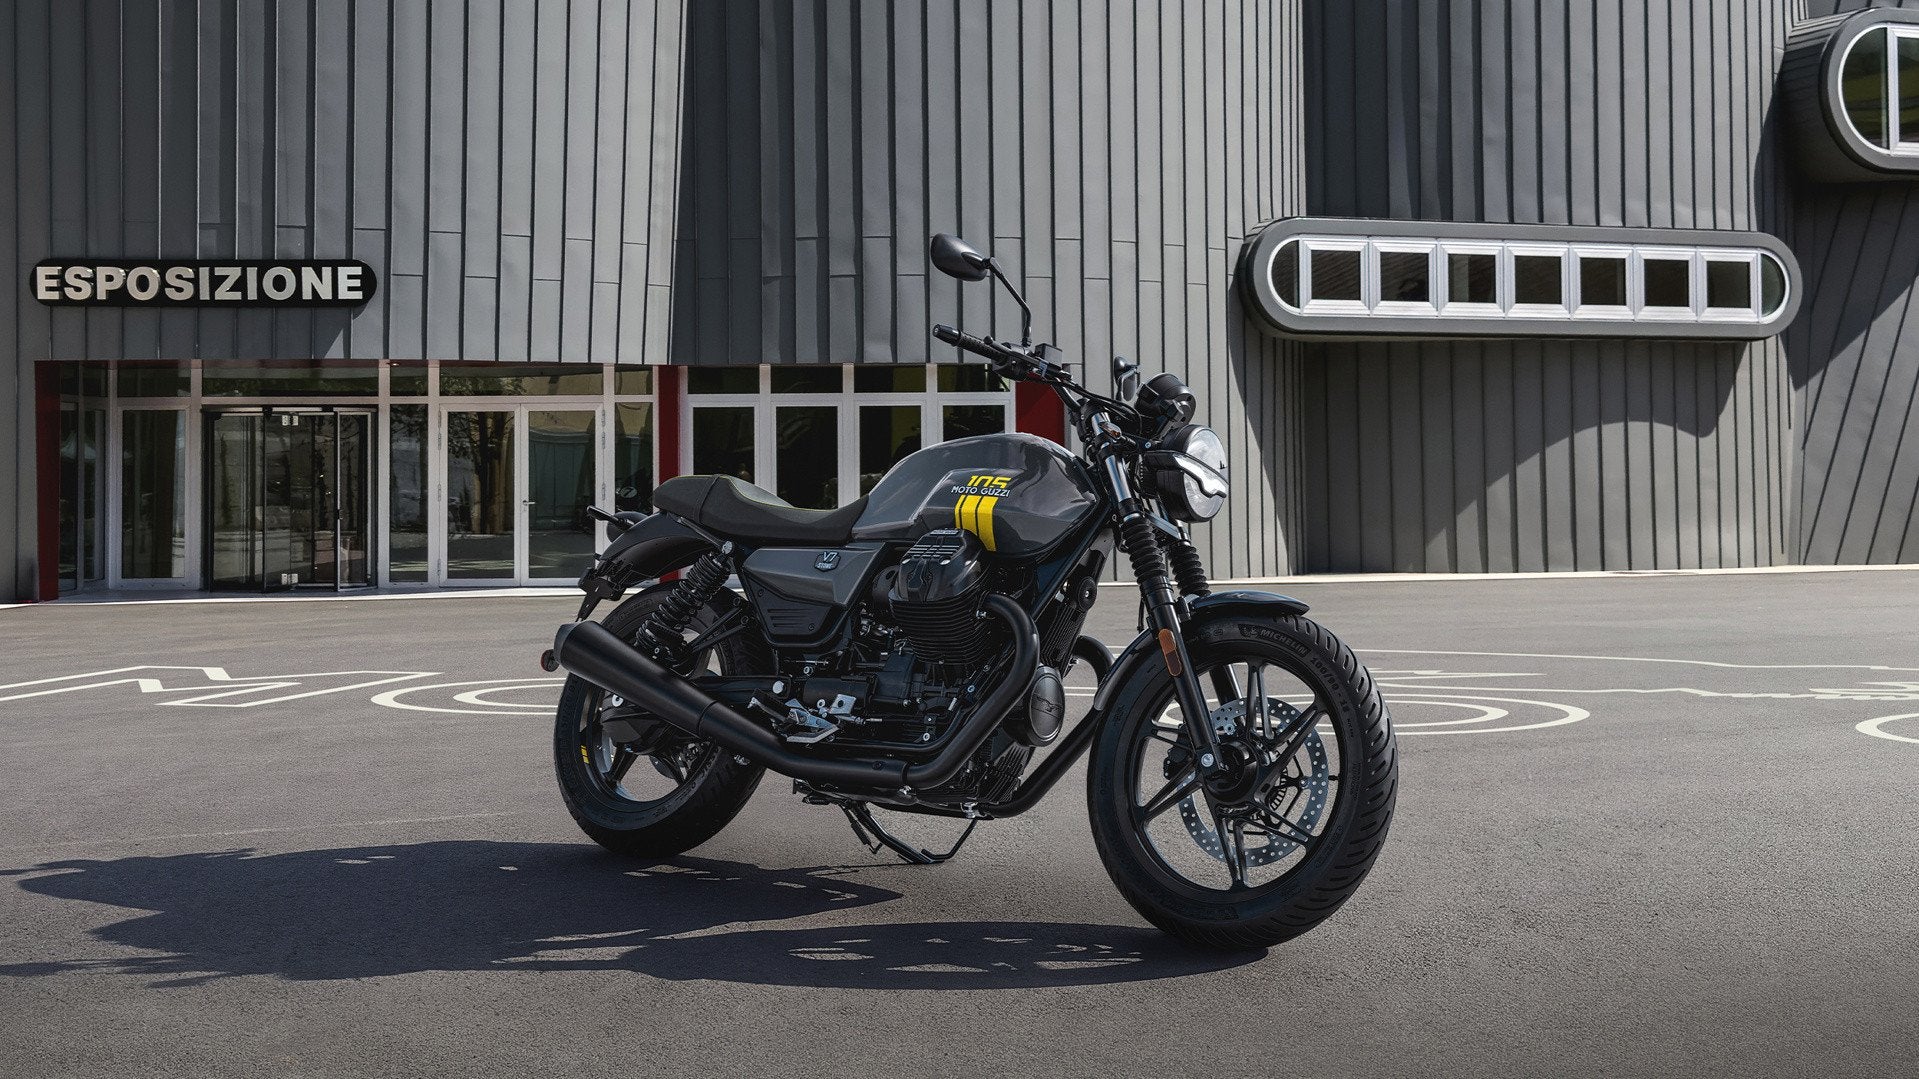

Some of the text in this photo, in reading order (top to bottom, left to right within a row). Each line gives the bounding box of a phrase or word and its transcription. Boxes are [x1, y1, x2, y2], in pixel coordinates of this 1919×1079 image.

[36, 266, 364, 301] ESPOSIZIONE
[967, 475, 1012, 489] 105
[951, 485, 1011, 498] MOTO GUZZI
[823, 551, 838, 562] V7
[1259, 629, 1308, 655] MICHELIN
